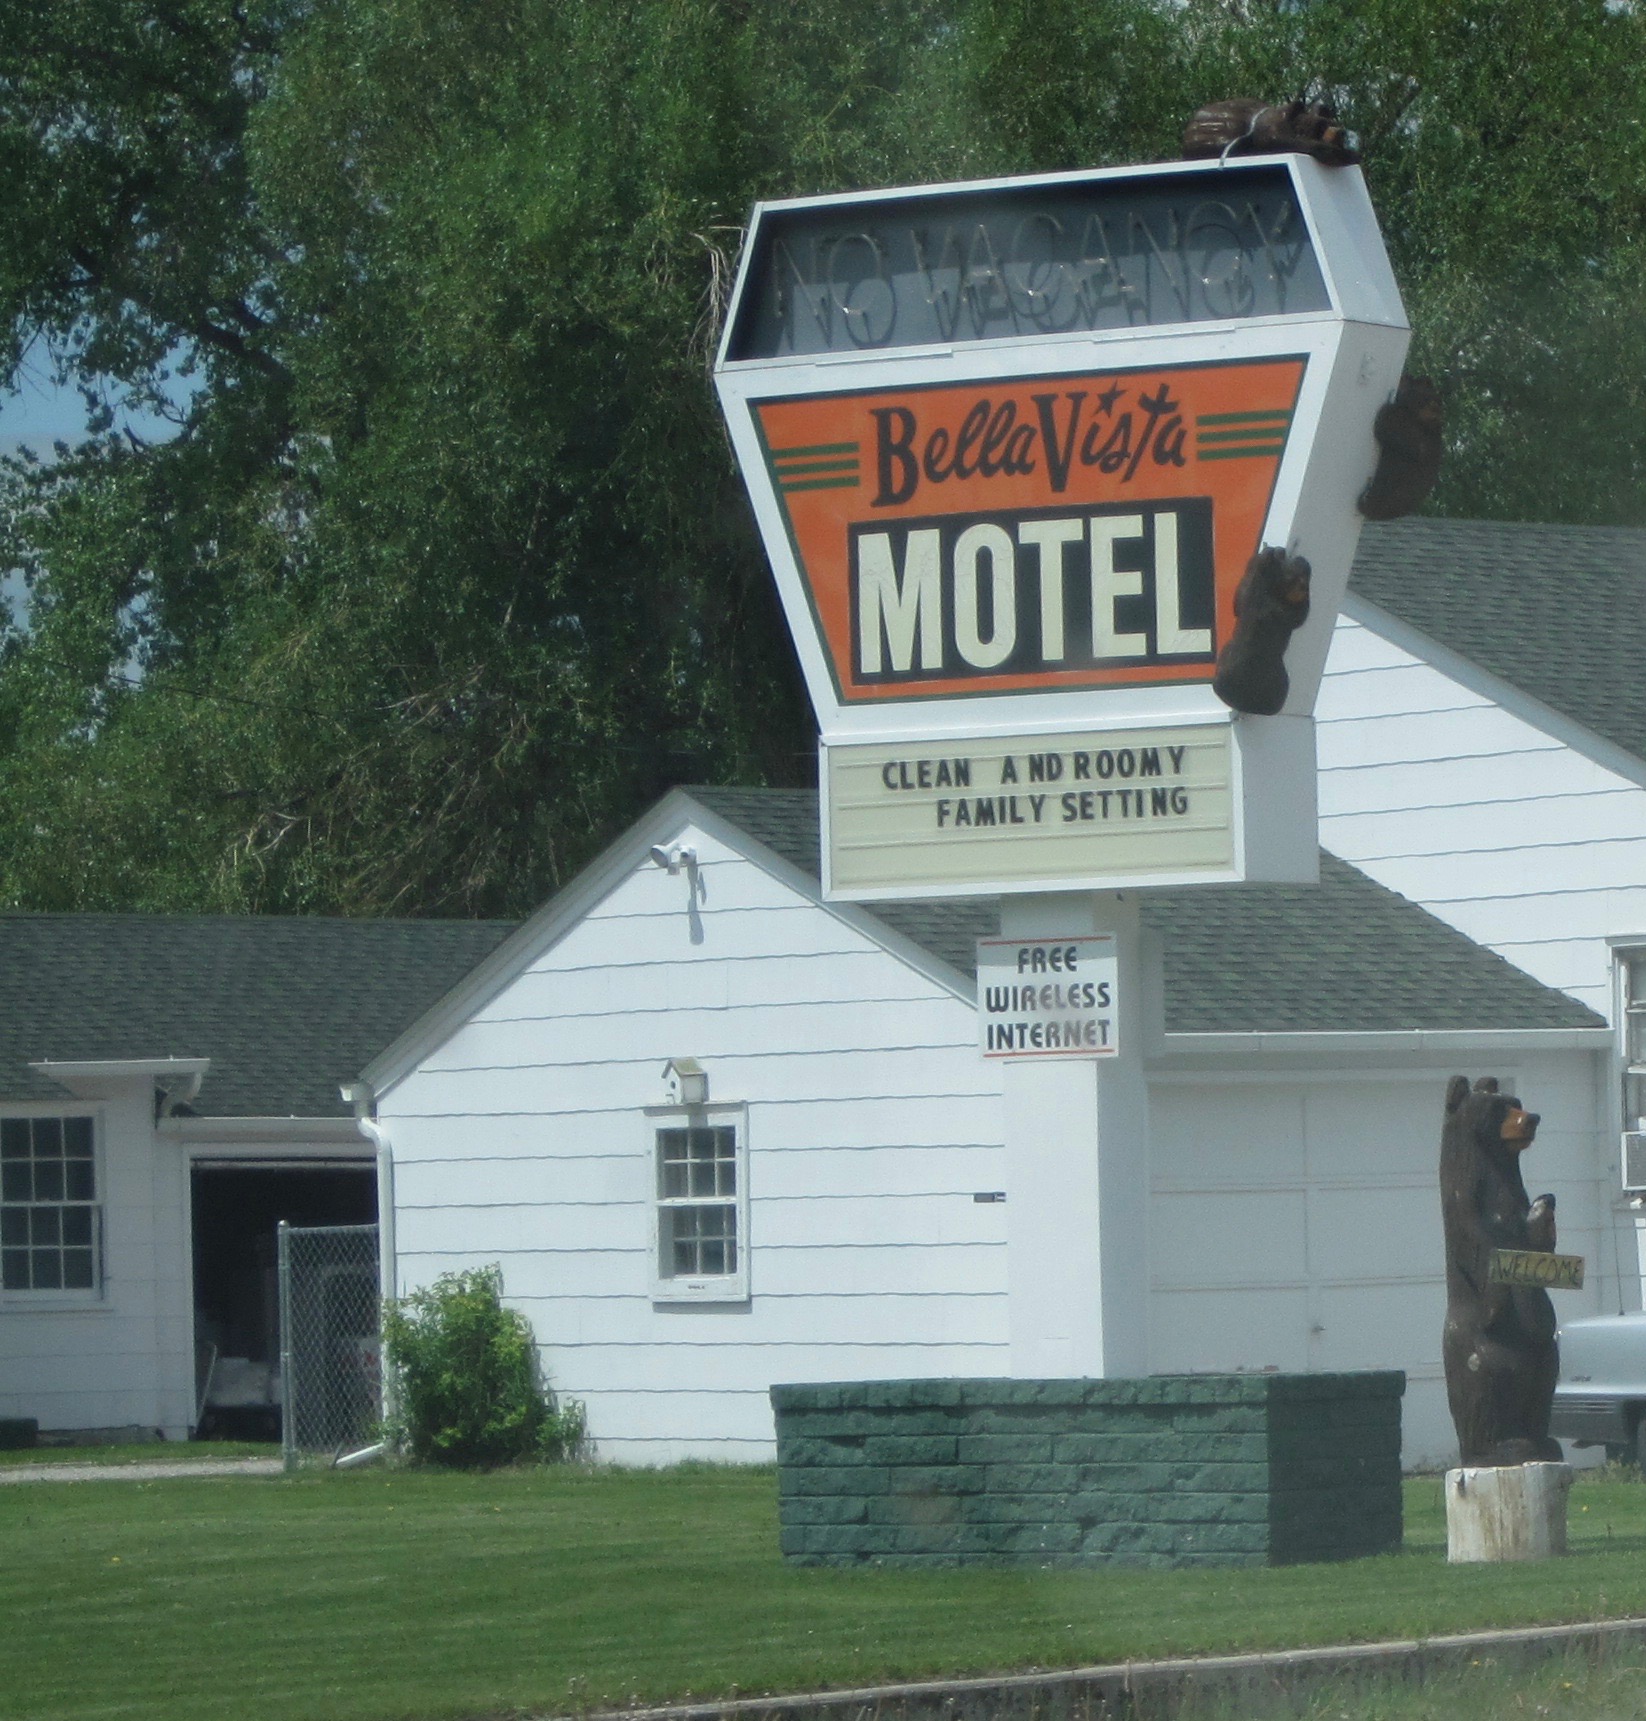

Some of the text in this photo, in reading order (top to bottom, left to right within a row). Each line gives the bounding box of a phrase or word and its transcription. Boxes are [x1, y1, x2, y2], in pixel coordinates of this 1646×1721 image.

[772, 200, 1294, 330] NO VACANCY
[869, 383, 1187, 508] Bella Vista
[858, 511, 1212, 674] MOTEL
[882, 745, 1186, 791] CLEAN AND ROOMY
[936, 786, 1188, 829] FAMILY SETTING
[1017, 946, 1078, 974] FREE
[985, 982, 1111, 1013] WIRELESS
[987, 1019, 1111, 1050] INTERNET
[1497, 1254, 1583, 1285] WELCOME
